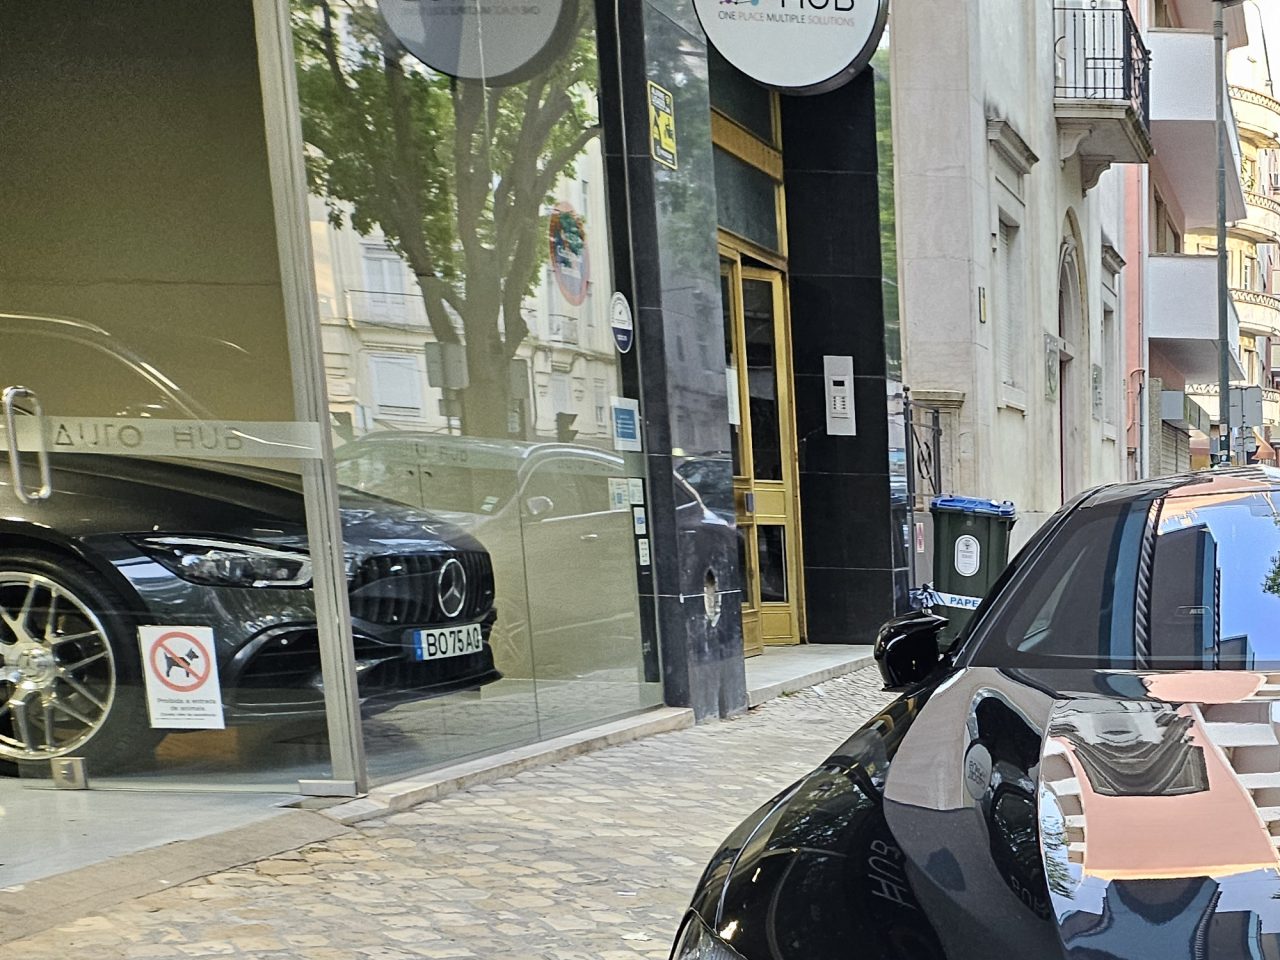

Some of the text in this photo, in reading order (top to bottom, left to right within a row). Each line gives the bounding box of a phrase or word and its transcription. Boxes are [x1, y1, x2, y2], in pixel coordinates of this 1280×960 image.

[718, 11, 856, 27] ONE PLACE MULTIPLE SOLUTIONS
[950, 596, 979, 608] PAPE
[449, 629, 465, 653] 75
